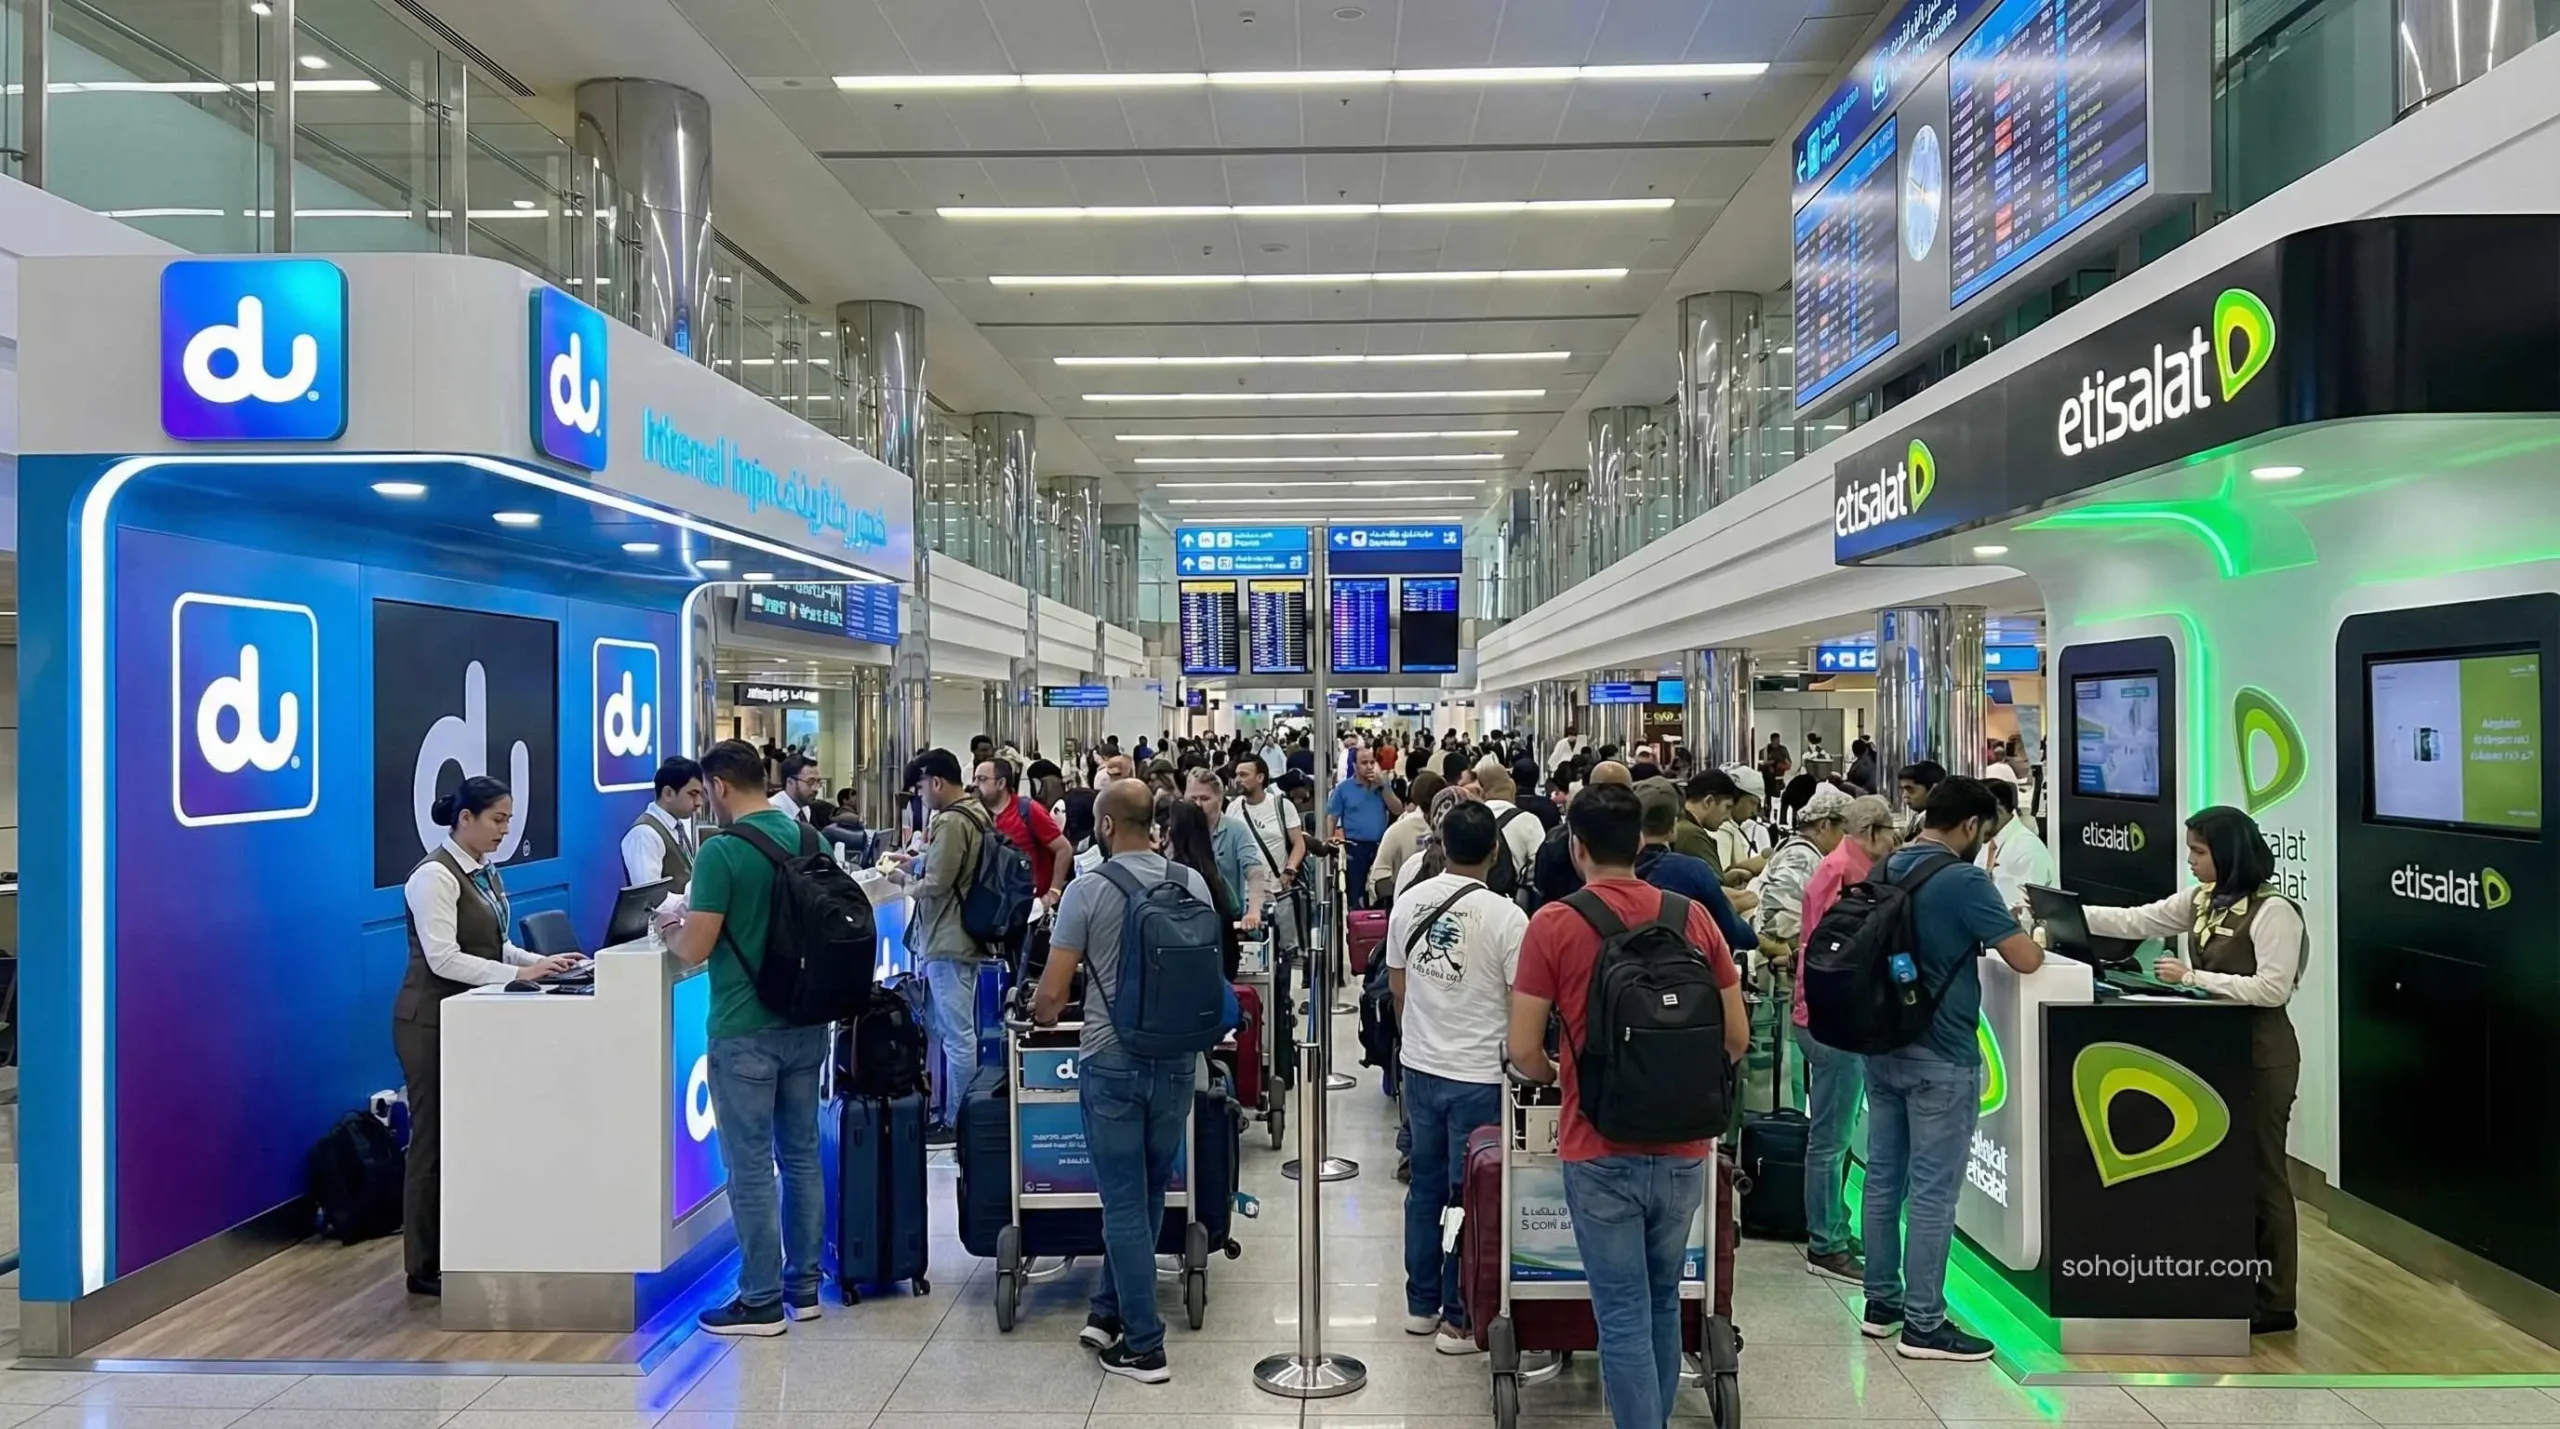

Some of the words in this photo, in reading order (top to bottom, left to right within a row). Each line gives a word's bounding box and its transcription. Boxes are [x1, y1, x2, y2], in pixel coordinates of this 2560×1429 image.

[182, 295, 318, 404] du
[549, 332, 601, 434] du
[2057, 326, 2212, 458] etisalat
[1835, 460, 1909, 538] etisalat
[196, 644, 299, 774] du
[603, 670, 652, 757] du
[2082, 822, 2130, 852] etisalat
[2390, 864, 2481, 909] etisalat
